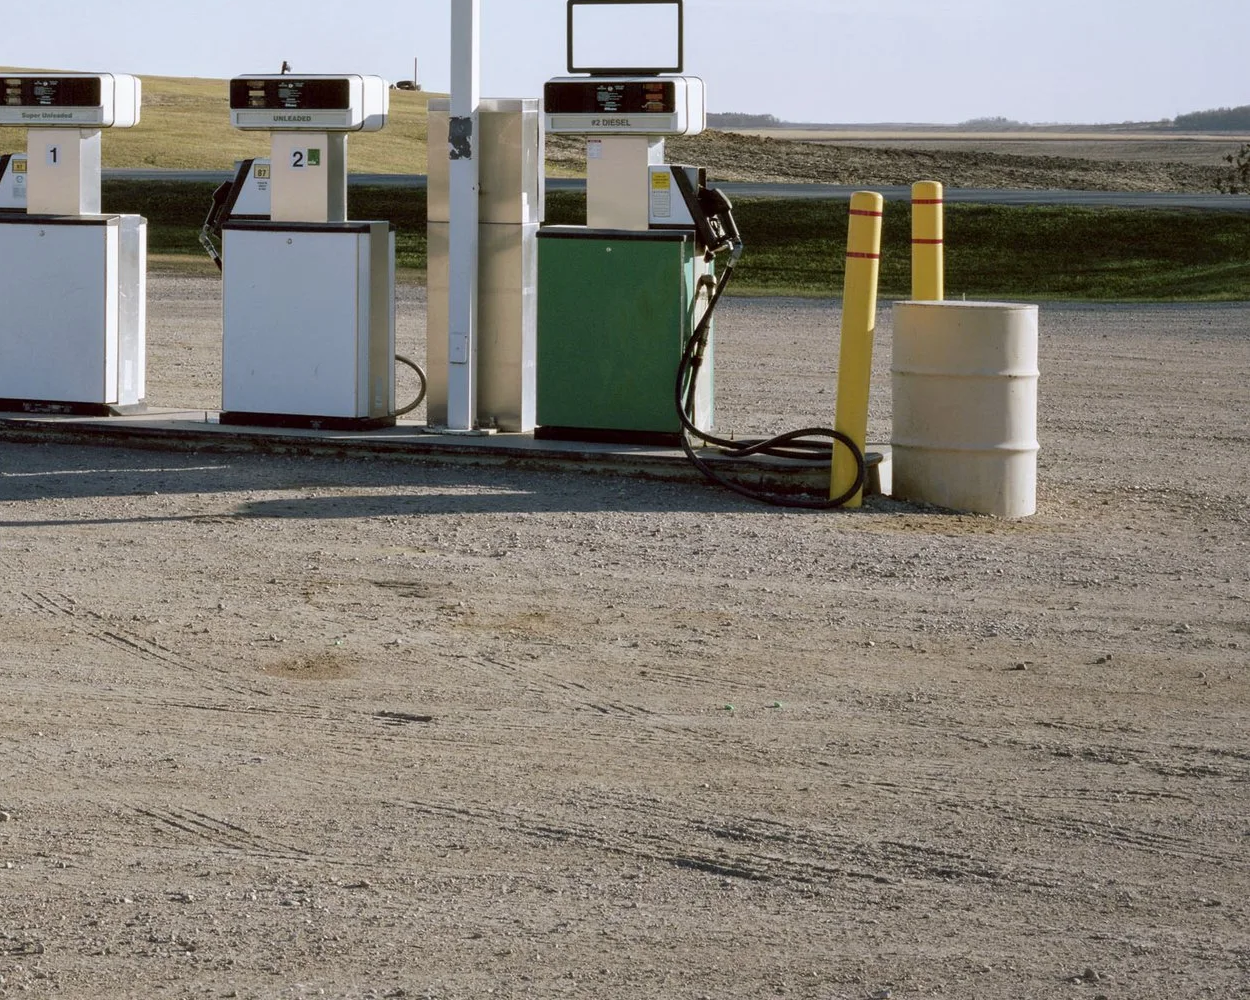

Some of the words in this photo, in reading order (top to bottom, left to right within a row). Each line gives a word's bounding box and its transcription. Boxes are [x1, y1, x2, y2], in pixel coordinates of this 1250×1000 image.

[602, 118, 631, 127] DIESEL
[49, 147, 57, 163] 1
[292, 151, 304, 167] 2
[257, 169, 267, 177] 87
